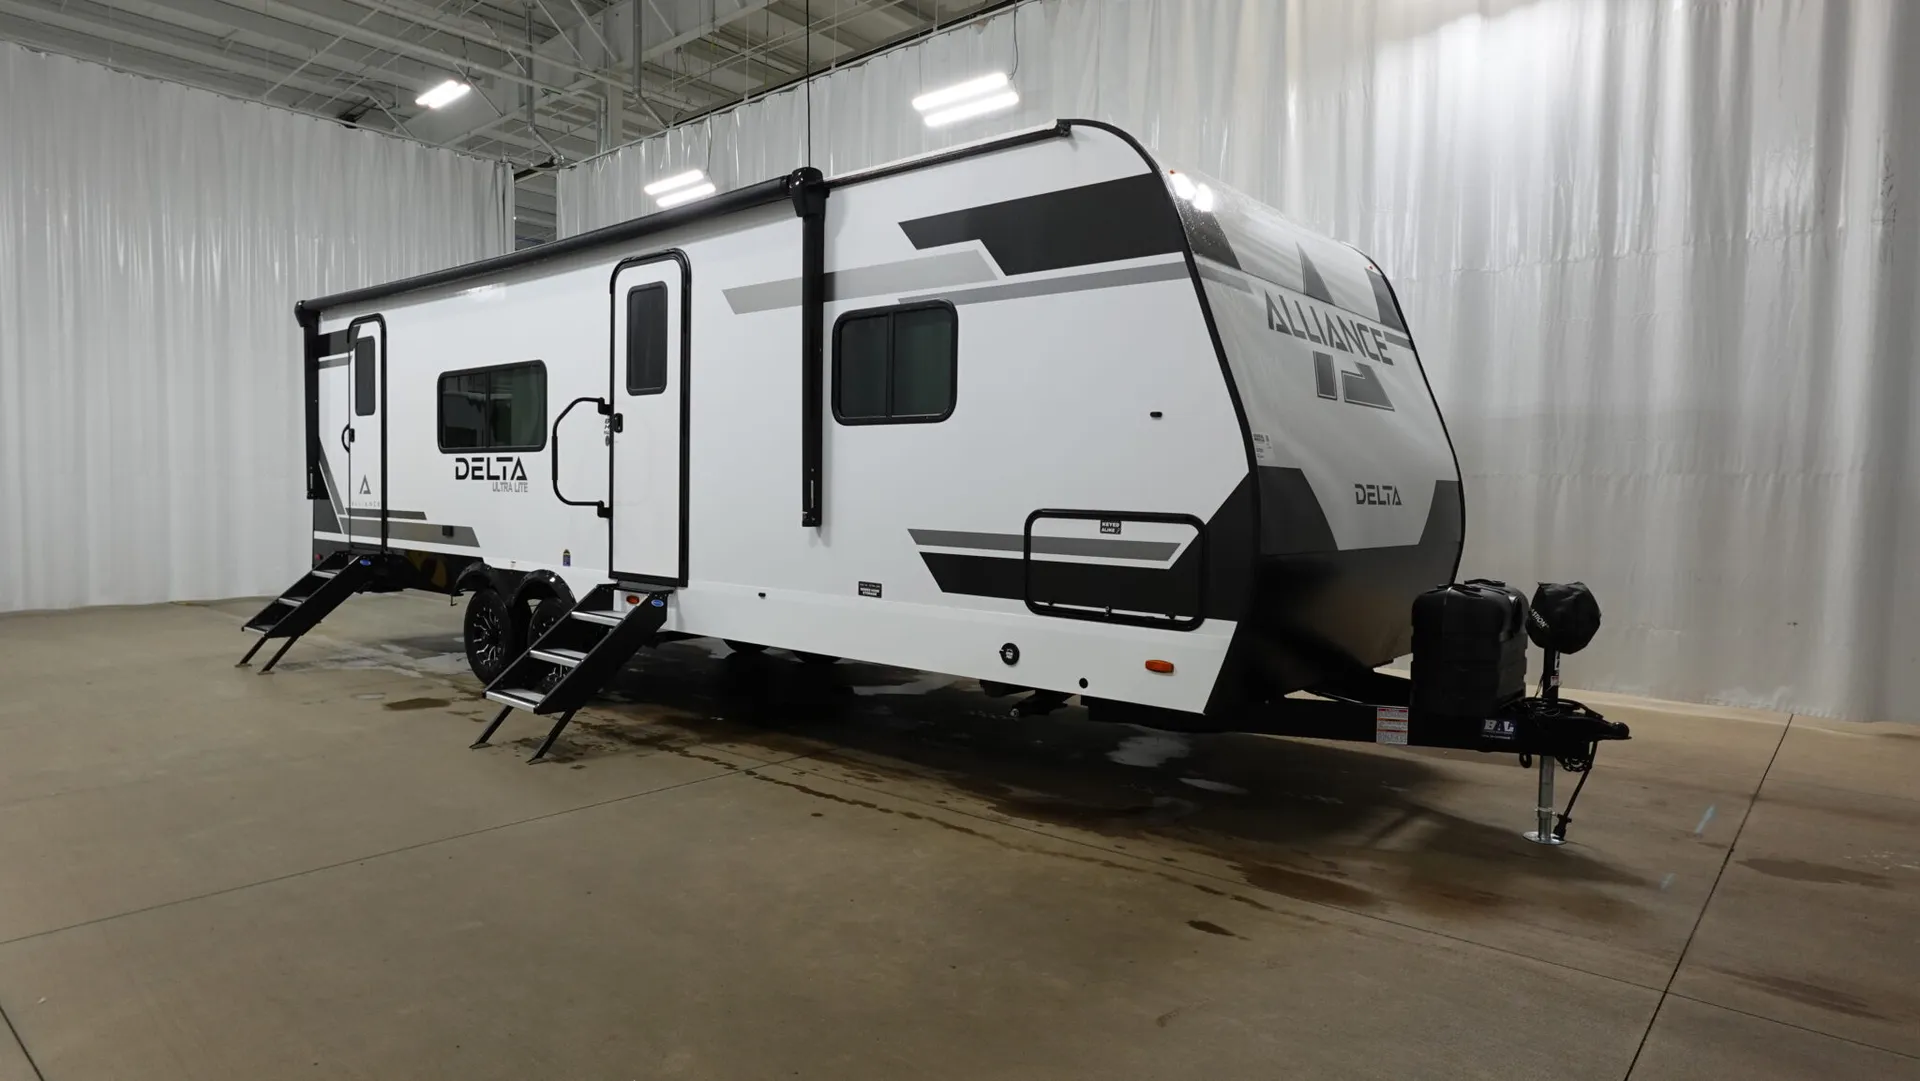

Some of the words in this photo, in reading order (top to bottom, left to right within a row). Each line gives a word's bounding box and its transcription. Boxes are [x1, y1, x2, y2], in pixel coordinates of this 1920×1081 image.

[1264, 290, 1394, 366] ALLIANCE
[454, 456, 527, 480] DELTA
[492, 482, 513, 492] ULTRA
[514, 482, 528, 493] LITE
[1355, 484, 1402, 505] DELTA
